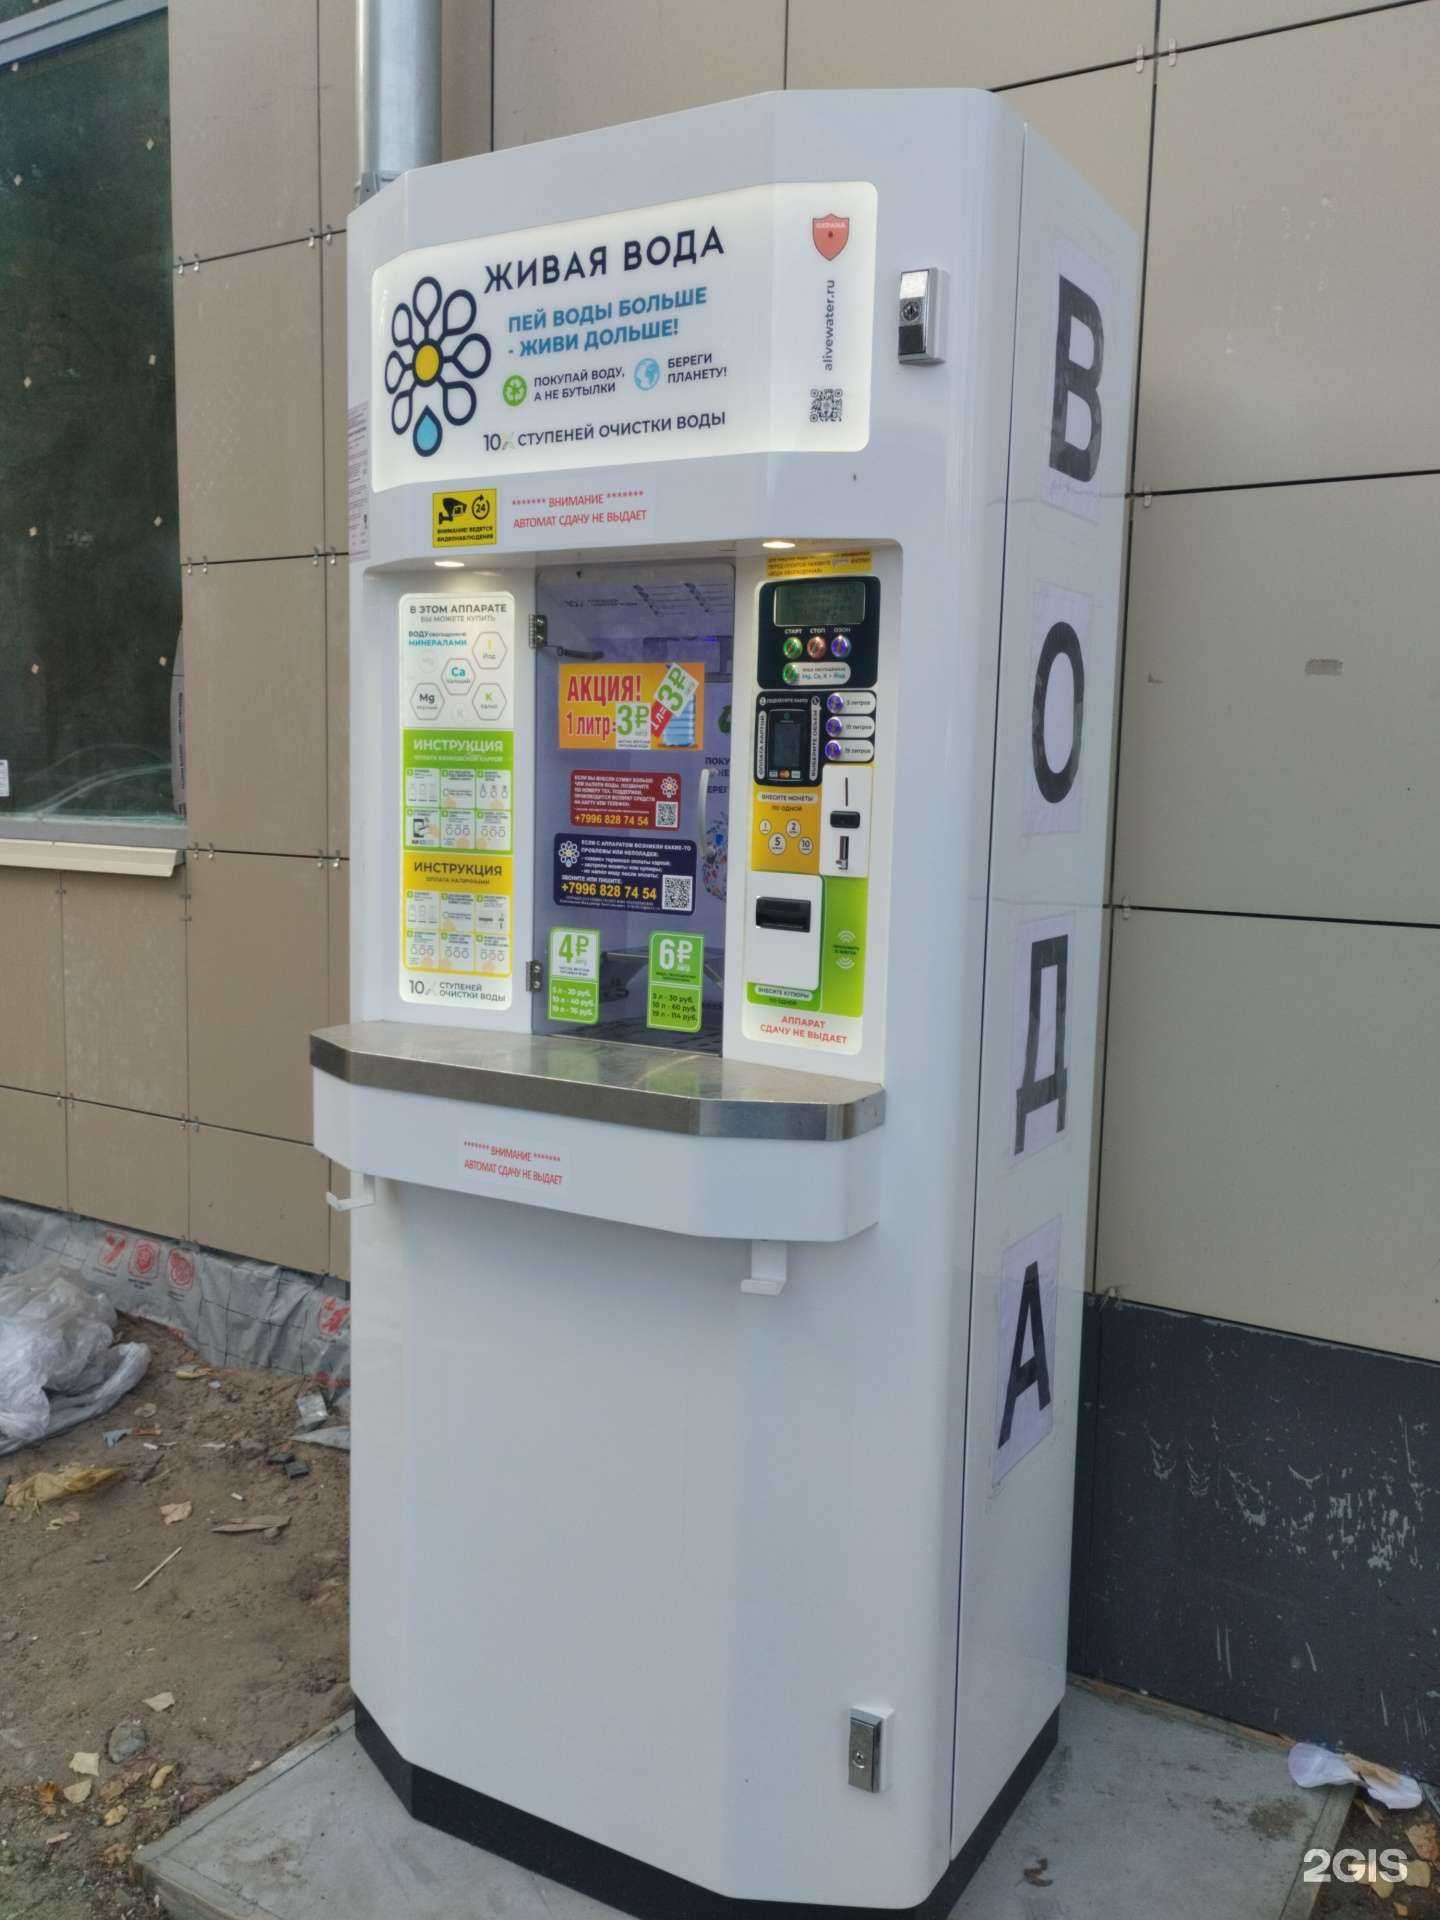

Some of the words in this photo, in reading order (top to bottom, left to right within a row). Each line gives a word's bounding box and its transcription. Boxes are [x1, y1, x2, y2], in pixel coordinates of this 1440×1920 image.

[484, 245, 607, 294] ЖИВАЯ
[624, 225, 725, 271] ВОДА
[508, 308, 546, 333] ПЕЙ
[553, 302, 612, 328] ВОДЫ
[619, 287, 708, 317] БОЛЬШЕ
[823, 280, 835, 371] alivewater.ru
[520, 333, 579, 357] ЖИВИ
[584, 318, 679, 351] ДОЛЬШЕ!
[668, 353, 712, 369] БЕРЕГИ
[534, 369, 587, 387] ПОКУПАЙ
[592, 366, 625, 382] ВОДУ,
[668, 367, 727, 384] ПЛАНЕТУ!
[534, 391, 542, 401] А
[545, 388, 559, 400] НЕ
[562, 382, 616, 399] БУТЫЛКИ
[483, 433, 501, 451] 10
[518, 424, 594, 446] СТУПЕНЕЙ
[599, 417, 672, 438] ОЧИСТКИ
[677, 411, 726, 430] ВОДЫ
[476, 503, 486, 513] 24
[548, 494, 604, 508] ВНИМАНИЕ
[513, 516, 555, 529] АВТОМАТ
[559, 513, 589, 526] СДАЧУ
[592, 511, 605, 523] НЕ
[608, 510, 648, 523] ВЫДАЕТ
[419, 605, 447, 613] ЭТОМ
[451, 604, 507, 613] АППАРАТЕ
[451, 667, 465, 677] Ca
[568, 675, 641, 706] АКЦИЯ!
[419, 694, 435, 704] Mg
[566, 711, 573, 735] 1
[576, 714, 616, 740] литр:
[413, 739, 503, 752] ИНСТРУКЦИЯ
[574, 814, 602, 824] +7996
[605, 815, 621, 824] 828
[624, 816, 635, 825] 74
[637, 816, 649, 826] 54
[775, 838, 780, 846] 5
[802, 840, 810, 848] 10
[414, 861, 502, 876] ИНСТРУКЦИЯ
[998, 273, 1104, 1449] ВОДА
[561, 882, 596, 895] +7996
[600, 884, 620, 896] 828
[625, 886, 638, 898] 74
[642, 888, 657, 900] 54
[409, 979, 425, 994] 10
[440, 982, 482, 991] СТУПЕНЕЙ
[440, 989, 478, 999] ОЧИСТКИ
[481, 993, 506, 1002] ВОДЫ
[781, 1016, 826, 1028] АППАРАТ
[761, 1024, 790, 1035] СДАЧУ
[793, 1029, 804, 1037] НЕ
[808, 1030, 847, 1044] ВЫДАЕТ
[491, 1146, 531, 1161] ВНИМАНИЕ
[465, 1160, 496, 1173] АВТОМАТ
[498, 1165, 520, 1178] СДАЧУ
[522, 1168, 531, 1179] НЕ
[533, 1172, 562, 1185] ВЫДАЕТ
